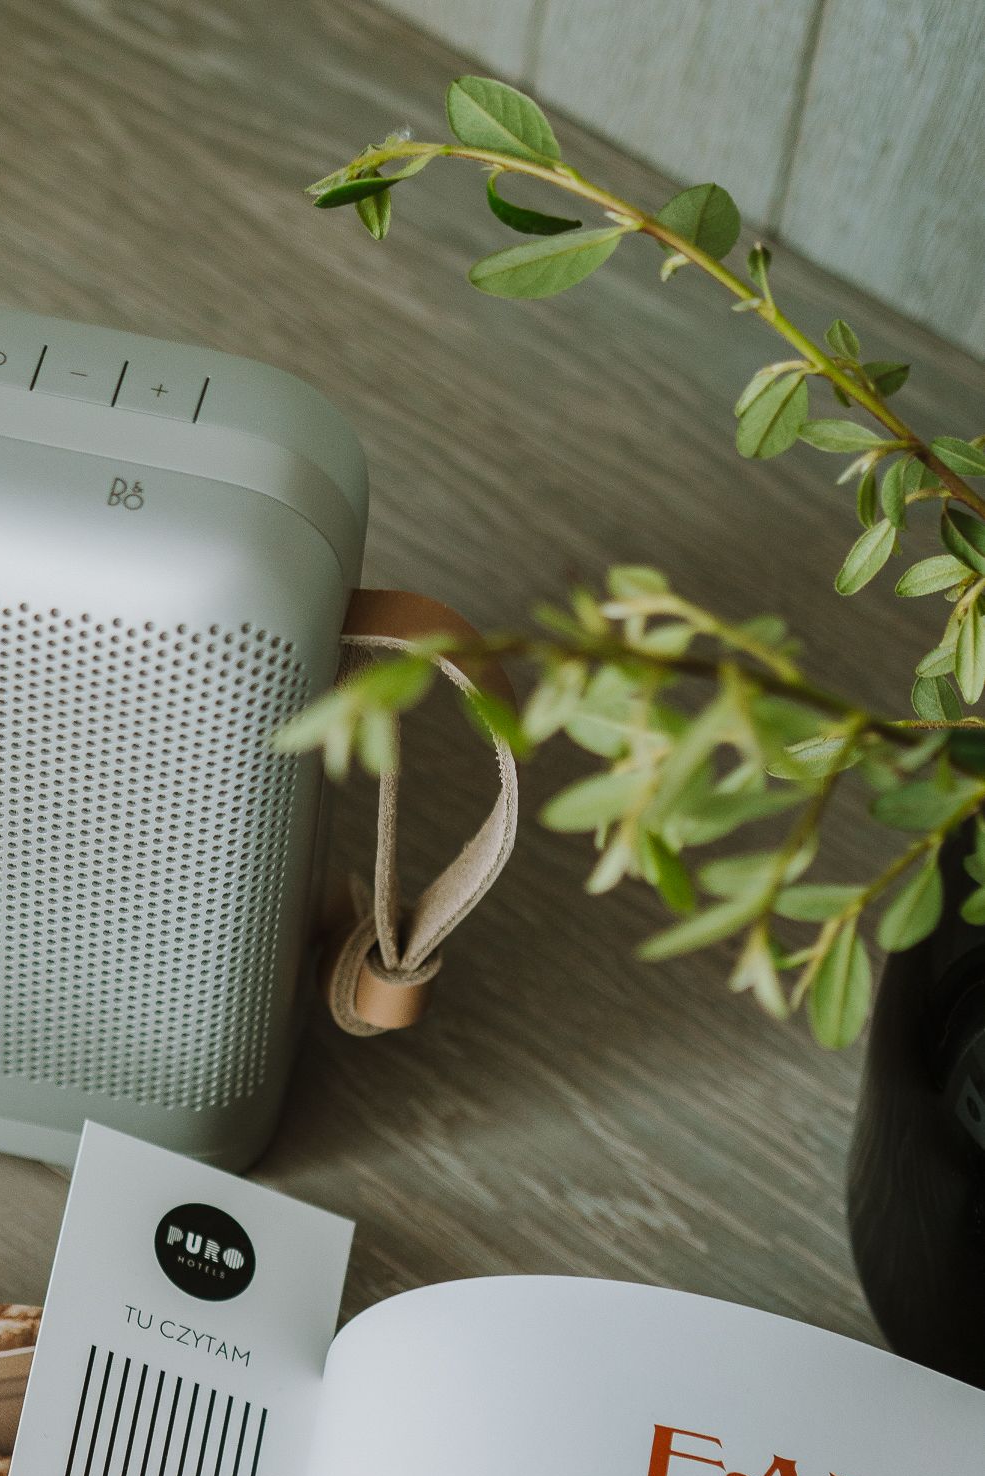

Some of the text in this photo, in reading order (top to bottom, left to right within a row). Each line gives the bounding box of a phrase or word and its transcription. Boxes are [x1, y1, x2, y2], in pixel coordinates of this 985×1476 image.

[167, 1225, 245, 1270] PURO
[177, 1255, 226, 1280] HOTELS
[125, 1304, 251, 1367] TU CZYTAM
